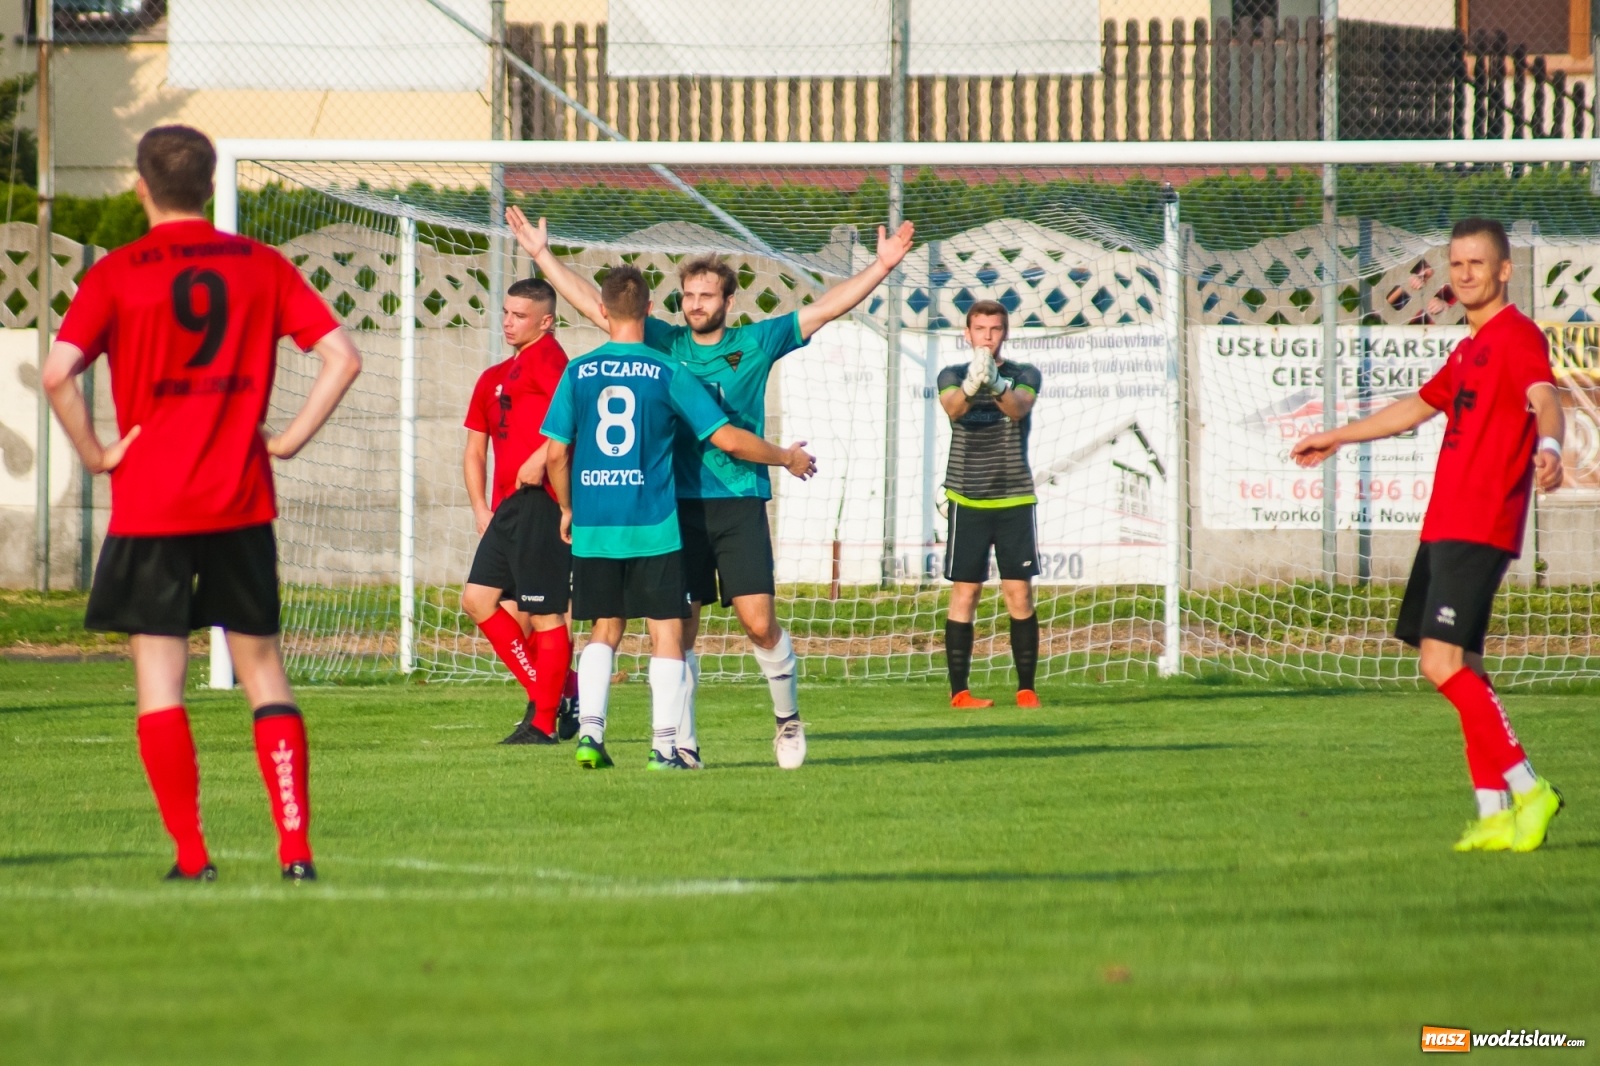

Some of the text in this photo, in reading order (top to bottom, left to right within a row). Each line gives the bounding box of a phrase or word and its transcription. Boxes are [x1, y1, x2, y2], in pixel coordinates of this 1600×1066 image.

[172, 265, 229, 369] 9
[1217, 338, 1455, 358] USŁUGI DEKARSK
[578, 361, 661, 379] KS CZARNI
[1272, 366, 1431, 387] CIESELSKIE
[596, 385, 636, 457] 8
[1239, 479, 1281, 499] tel.
[1355, 479, 1402, 500] 196
[1252, 507, 1342, 525] Tworkó,
[1351, 507, 1372, 522] ul.
